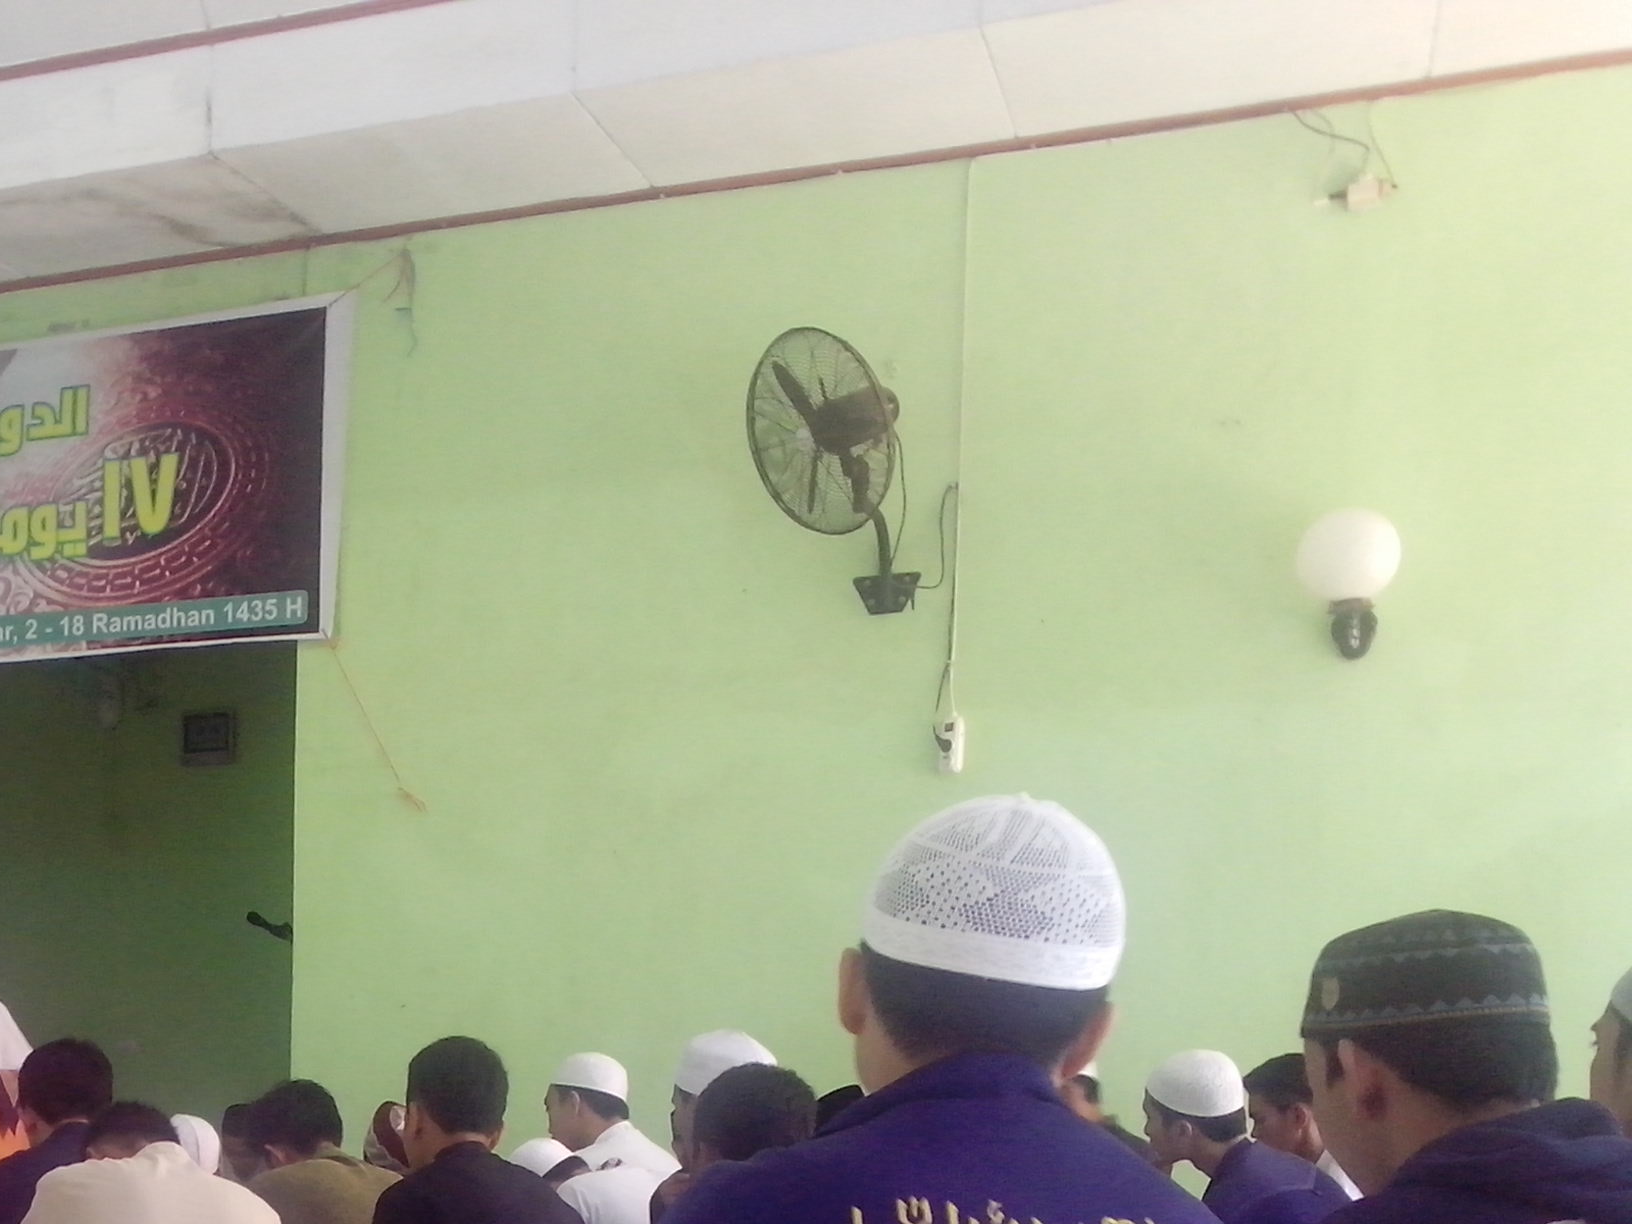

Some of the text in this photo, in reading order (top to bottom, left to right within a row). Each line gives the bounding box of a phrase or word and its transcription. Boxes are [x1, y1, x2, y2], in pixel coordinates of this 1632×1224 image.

[24, 619, 38, 640] 2
[60, 614, 85, 637] 18
[92, 604, 216, 635] Ramadhan
[223, 598, 279, 624] 1435
[286, 596, 303, 619] H
